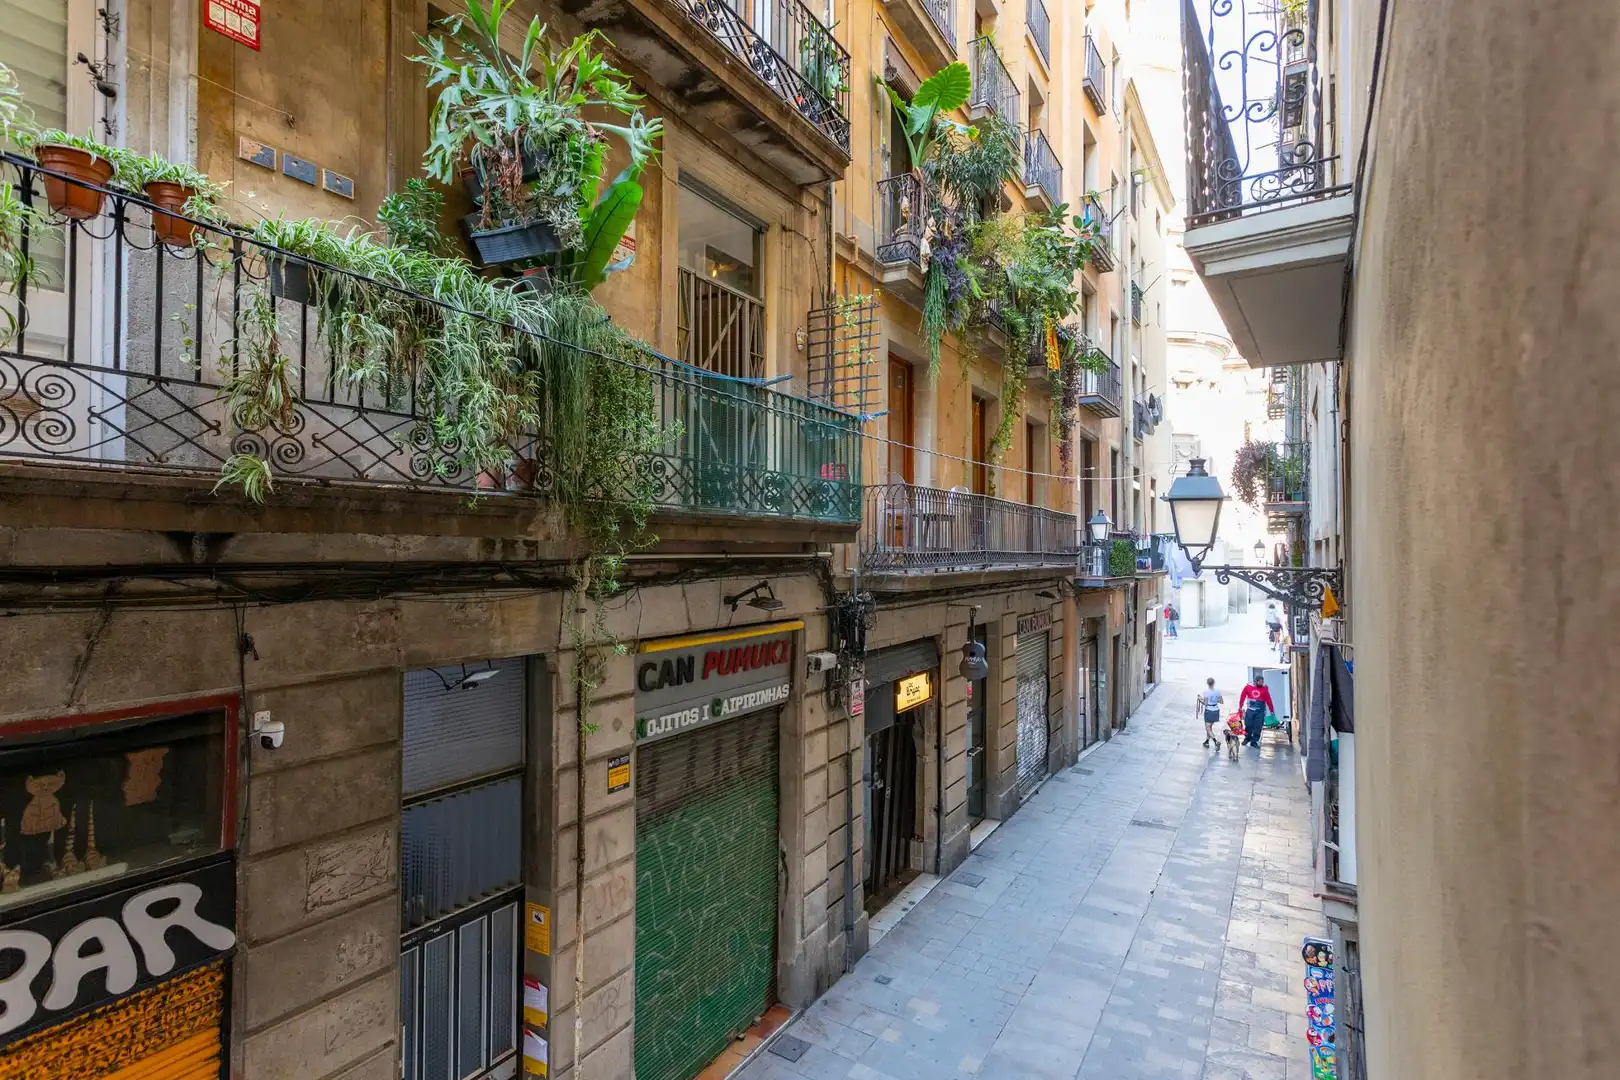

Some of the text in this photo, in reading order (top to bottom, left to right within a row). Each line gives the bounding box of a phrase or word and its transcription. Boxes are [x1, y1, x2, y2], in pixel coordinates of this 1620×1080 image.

[638, 640, 791, 692] CAN PUMUKI
[702, 704, 709, 721] I
[712, 684, 790, 717] CAIPIRINHAS
[0, 882, 236, 1035] BAR
